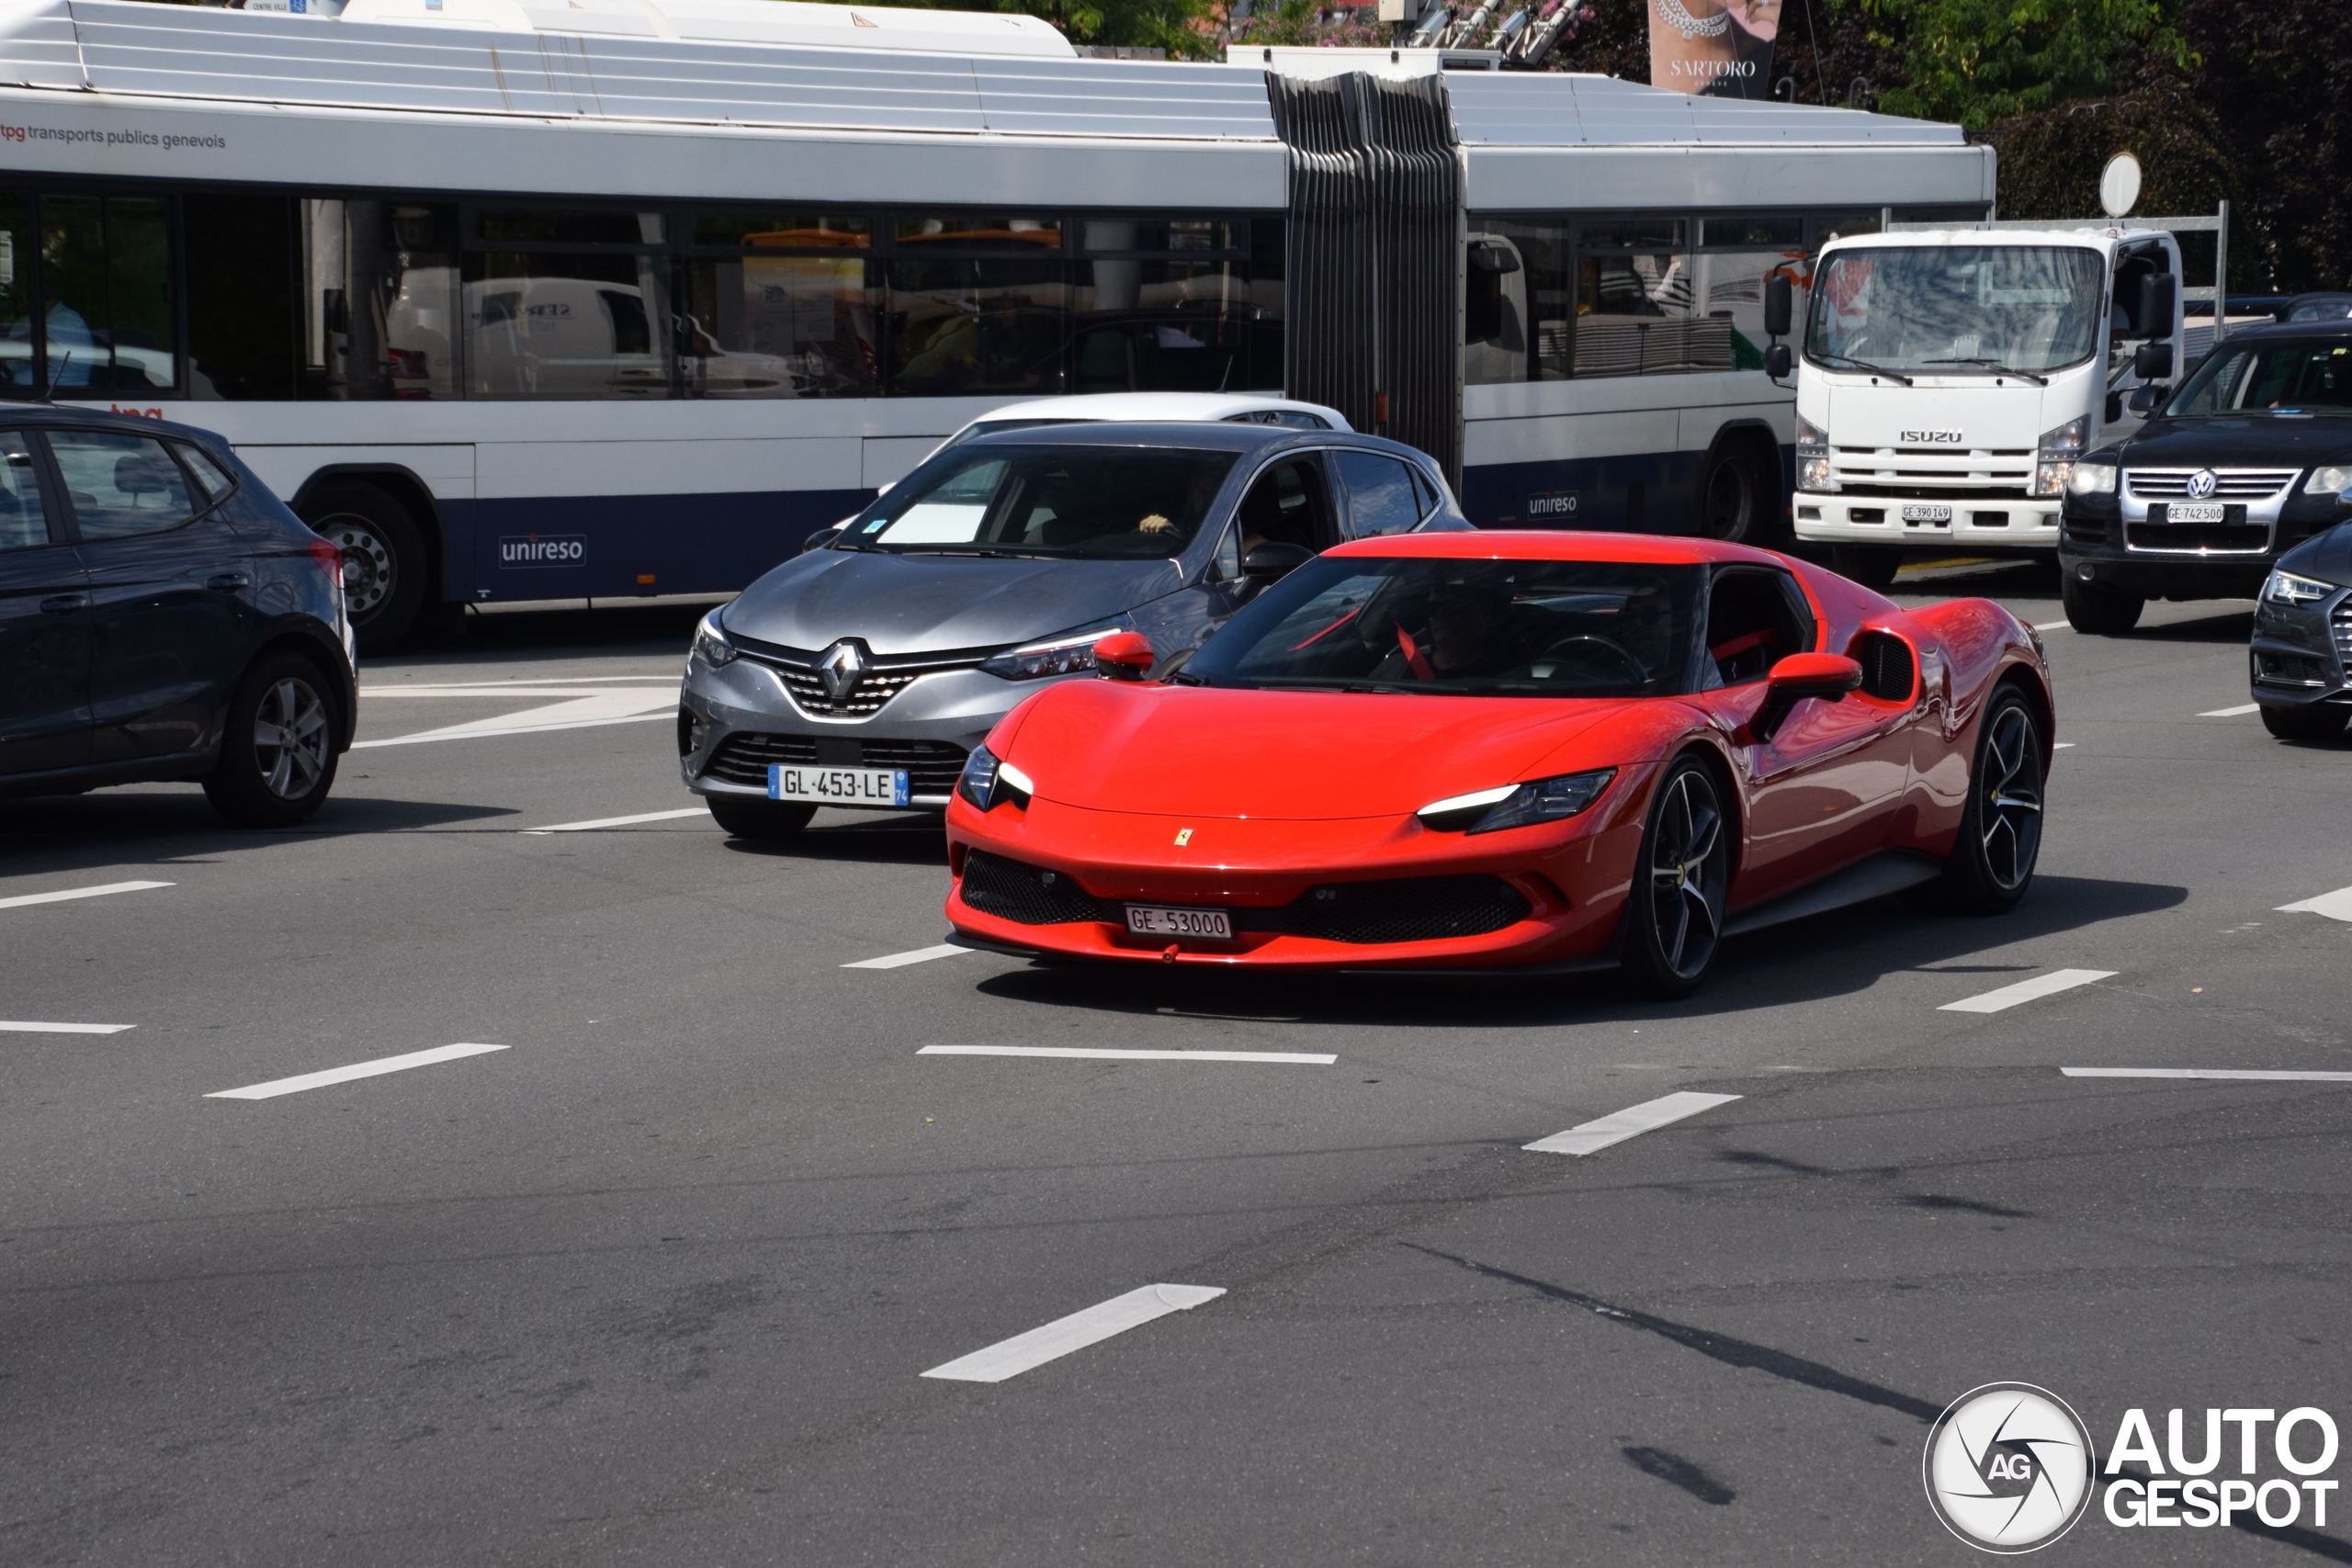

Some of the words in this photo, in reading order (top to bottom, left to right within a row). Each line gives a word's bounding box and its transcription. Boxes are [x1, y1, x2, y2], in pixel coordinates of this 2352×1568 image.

[1670, 60, 1756, 77] SARTORO
[0, 123, 26, 142] tpg
[28, 125, 105, 145] transports
[107, 129, 159, 147] publics
[163, 134, 226, 151] genevois
[1900, 430, 1962, 443] ISUZU
[1530, 491, 1577, 514] unireso
[502, 535, 583, 561] unireso
[895, 789, 908, 802] 74
